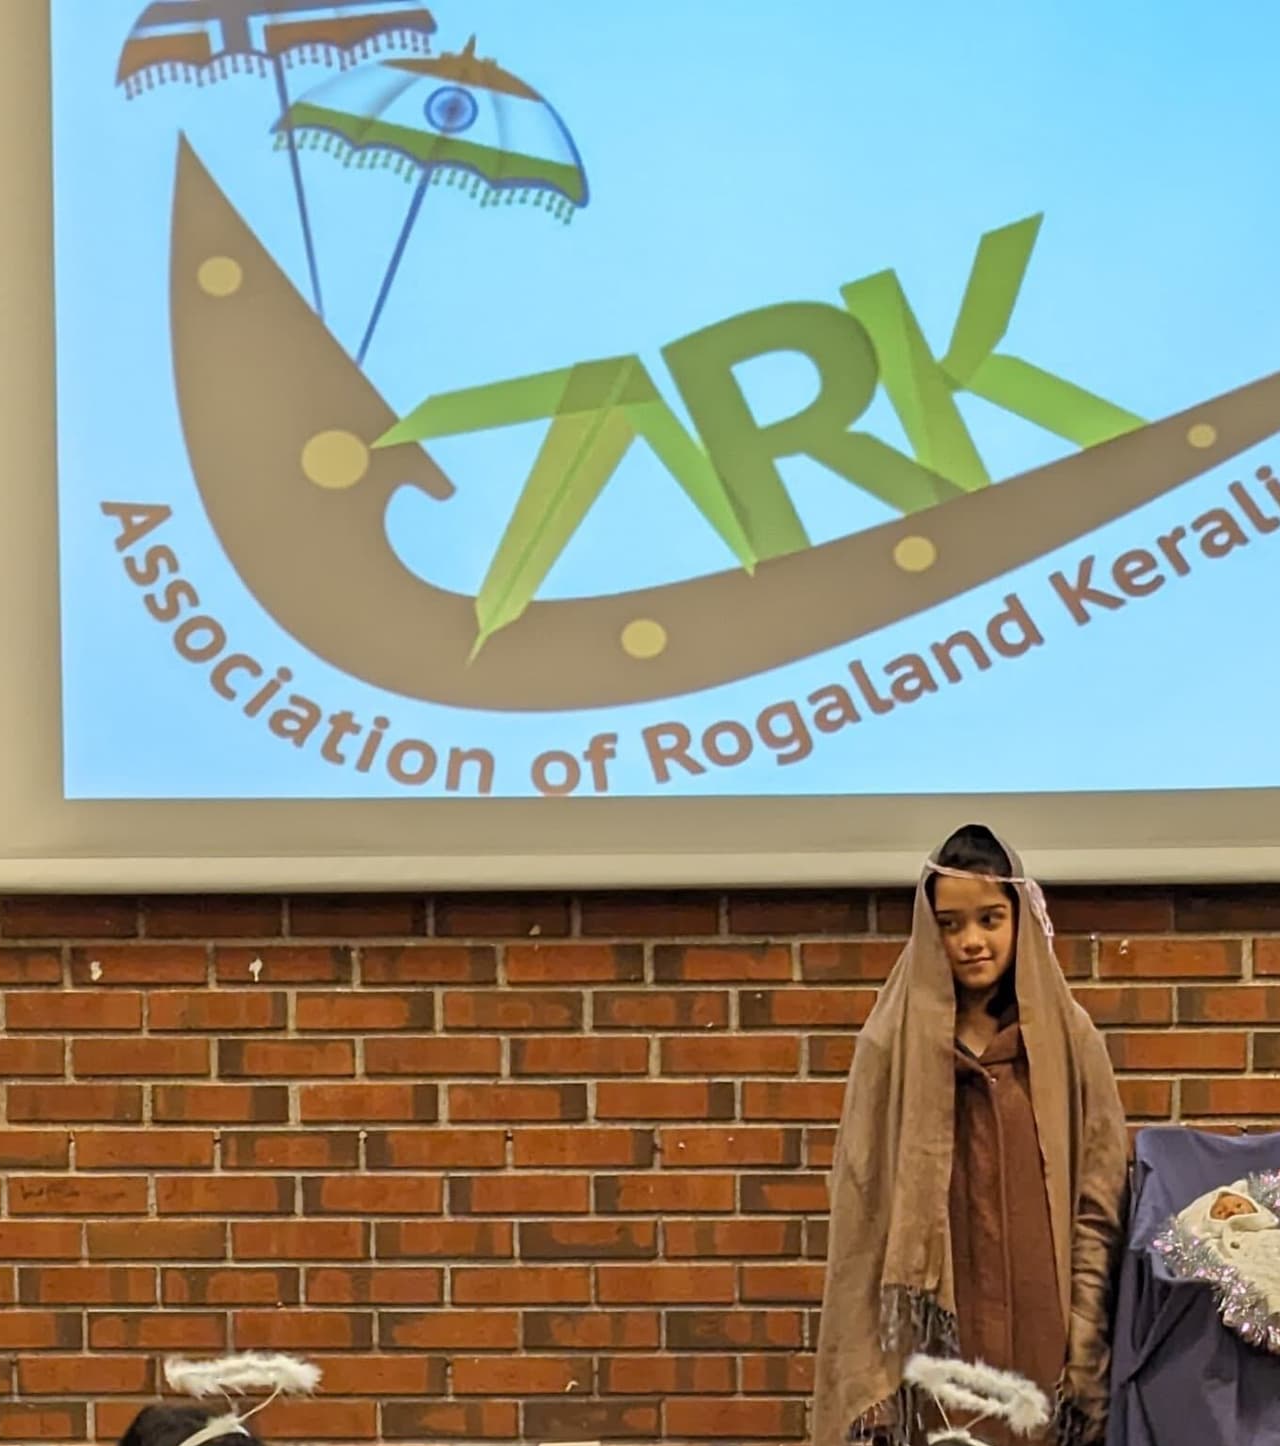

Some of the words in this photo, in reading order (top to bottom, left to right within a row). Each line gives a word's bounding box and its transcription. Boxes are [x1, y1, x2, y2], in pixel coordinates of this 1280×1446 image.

[99, 500, 496, 795] Association
[530, 731, 619, 797] of
[641, 593, 1045, 784] Rogaland
